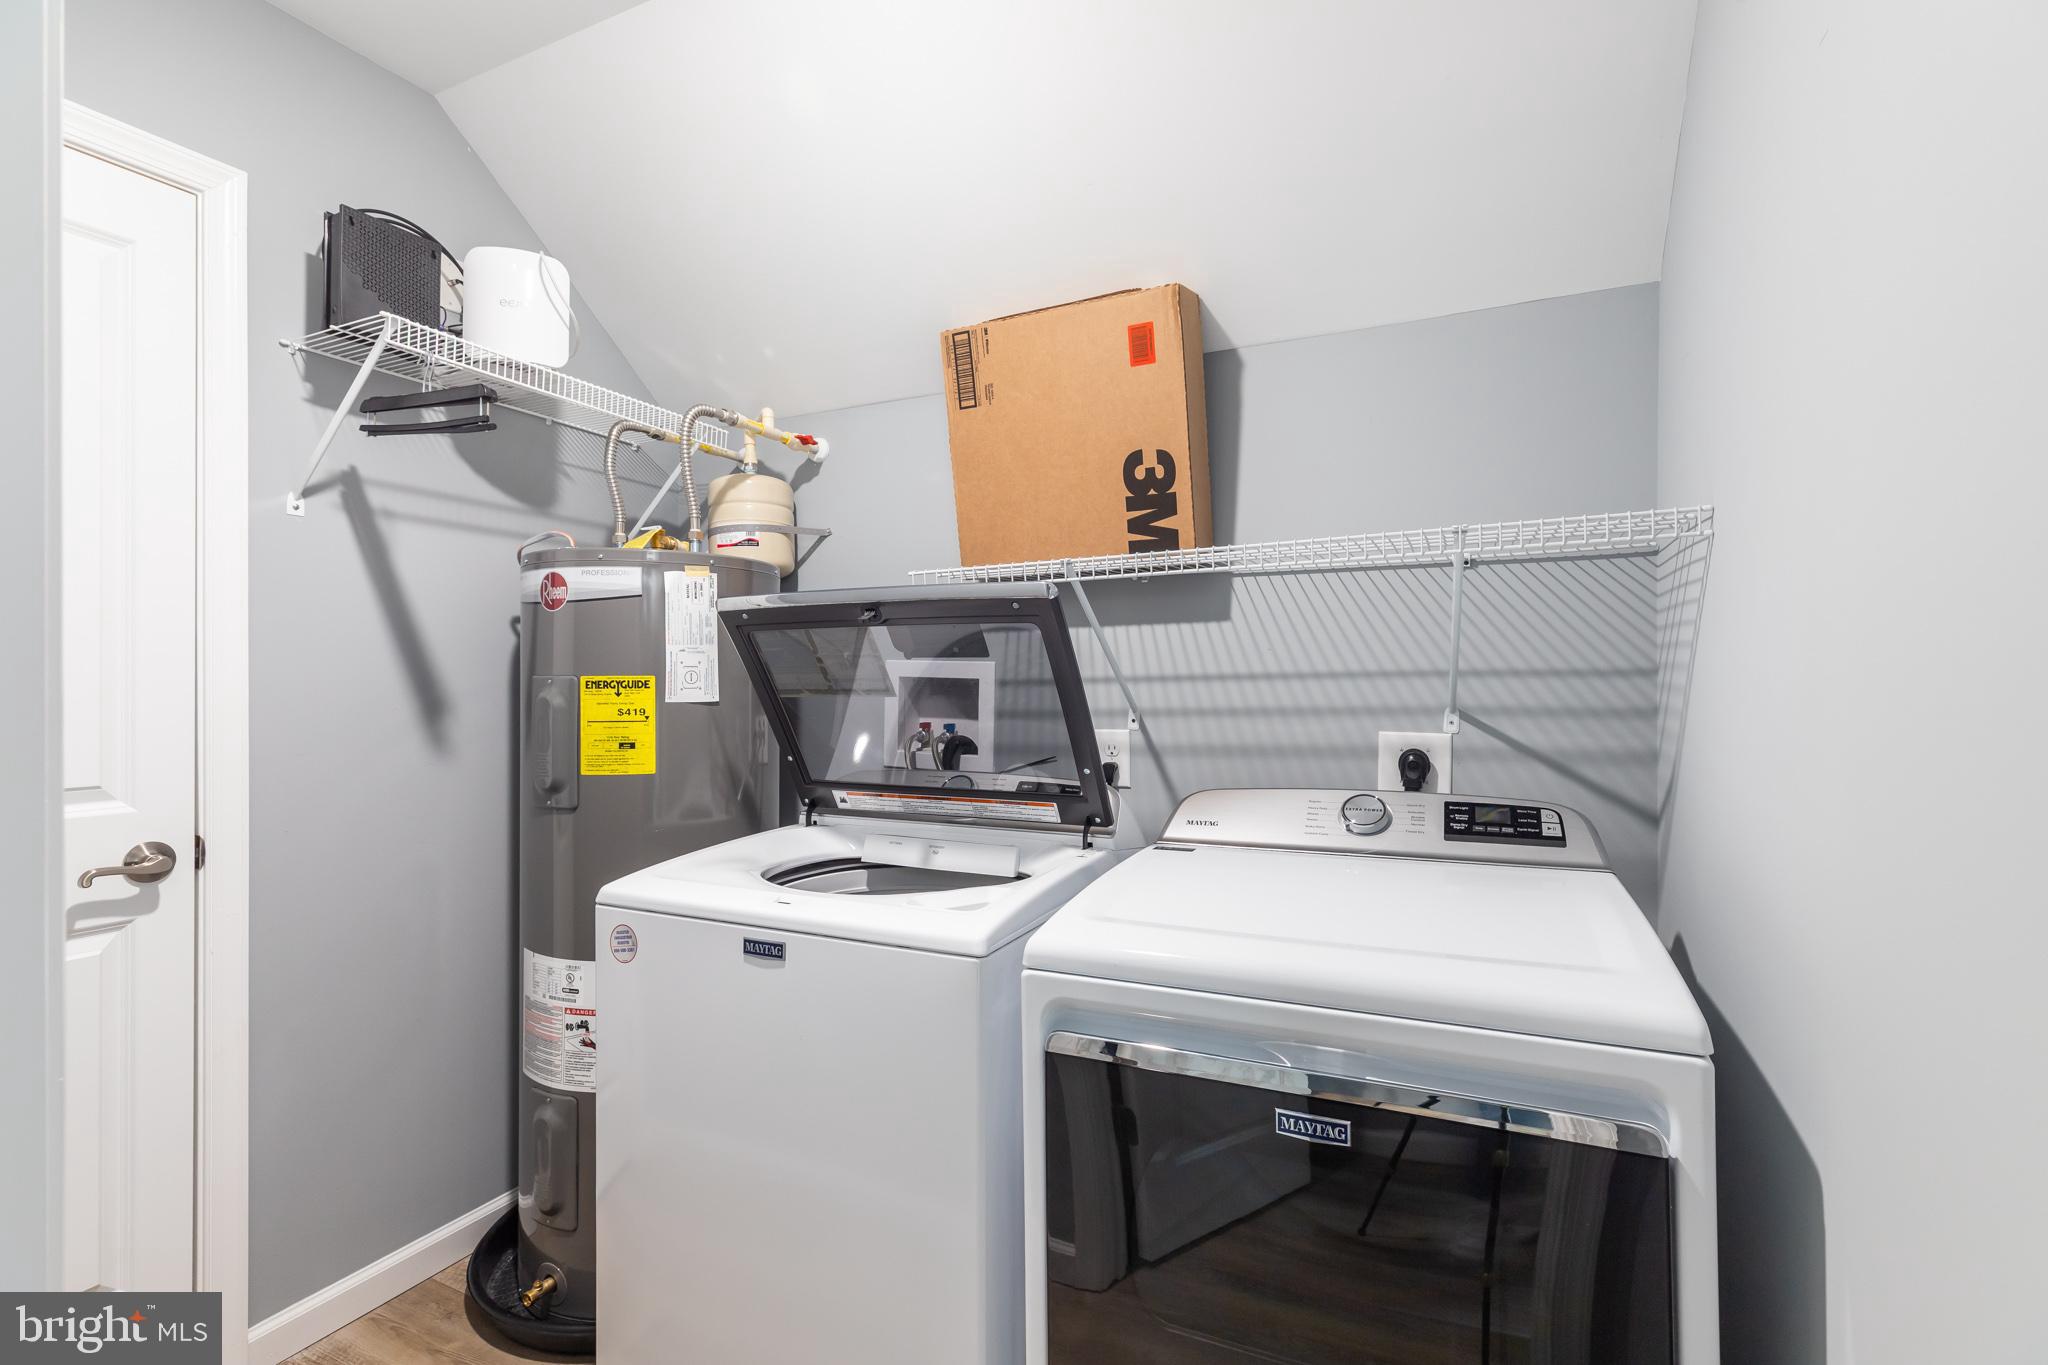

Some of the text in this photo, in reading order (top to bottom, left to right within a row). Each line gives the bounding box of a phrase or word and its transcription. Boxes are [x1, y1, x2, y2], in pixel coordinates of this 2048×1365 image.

[1123, 448, 1180, 554] 3M
[542, 572, 567, 605] Rheem
[617, 708, 646, 717] $419
[1185, 819, 1219, 827] MAYTAG
[744, 941, 783, 956] MAYTAG
[1280, 1116, 1347, 1141] MAYTAG
